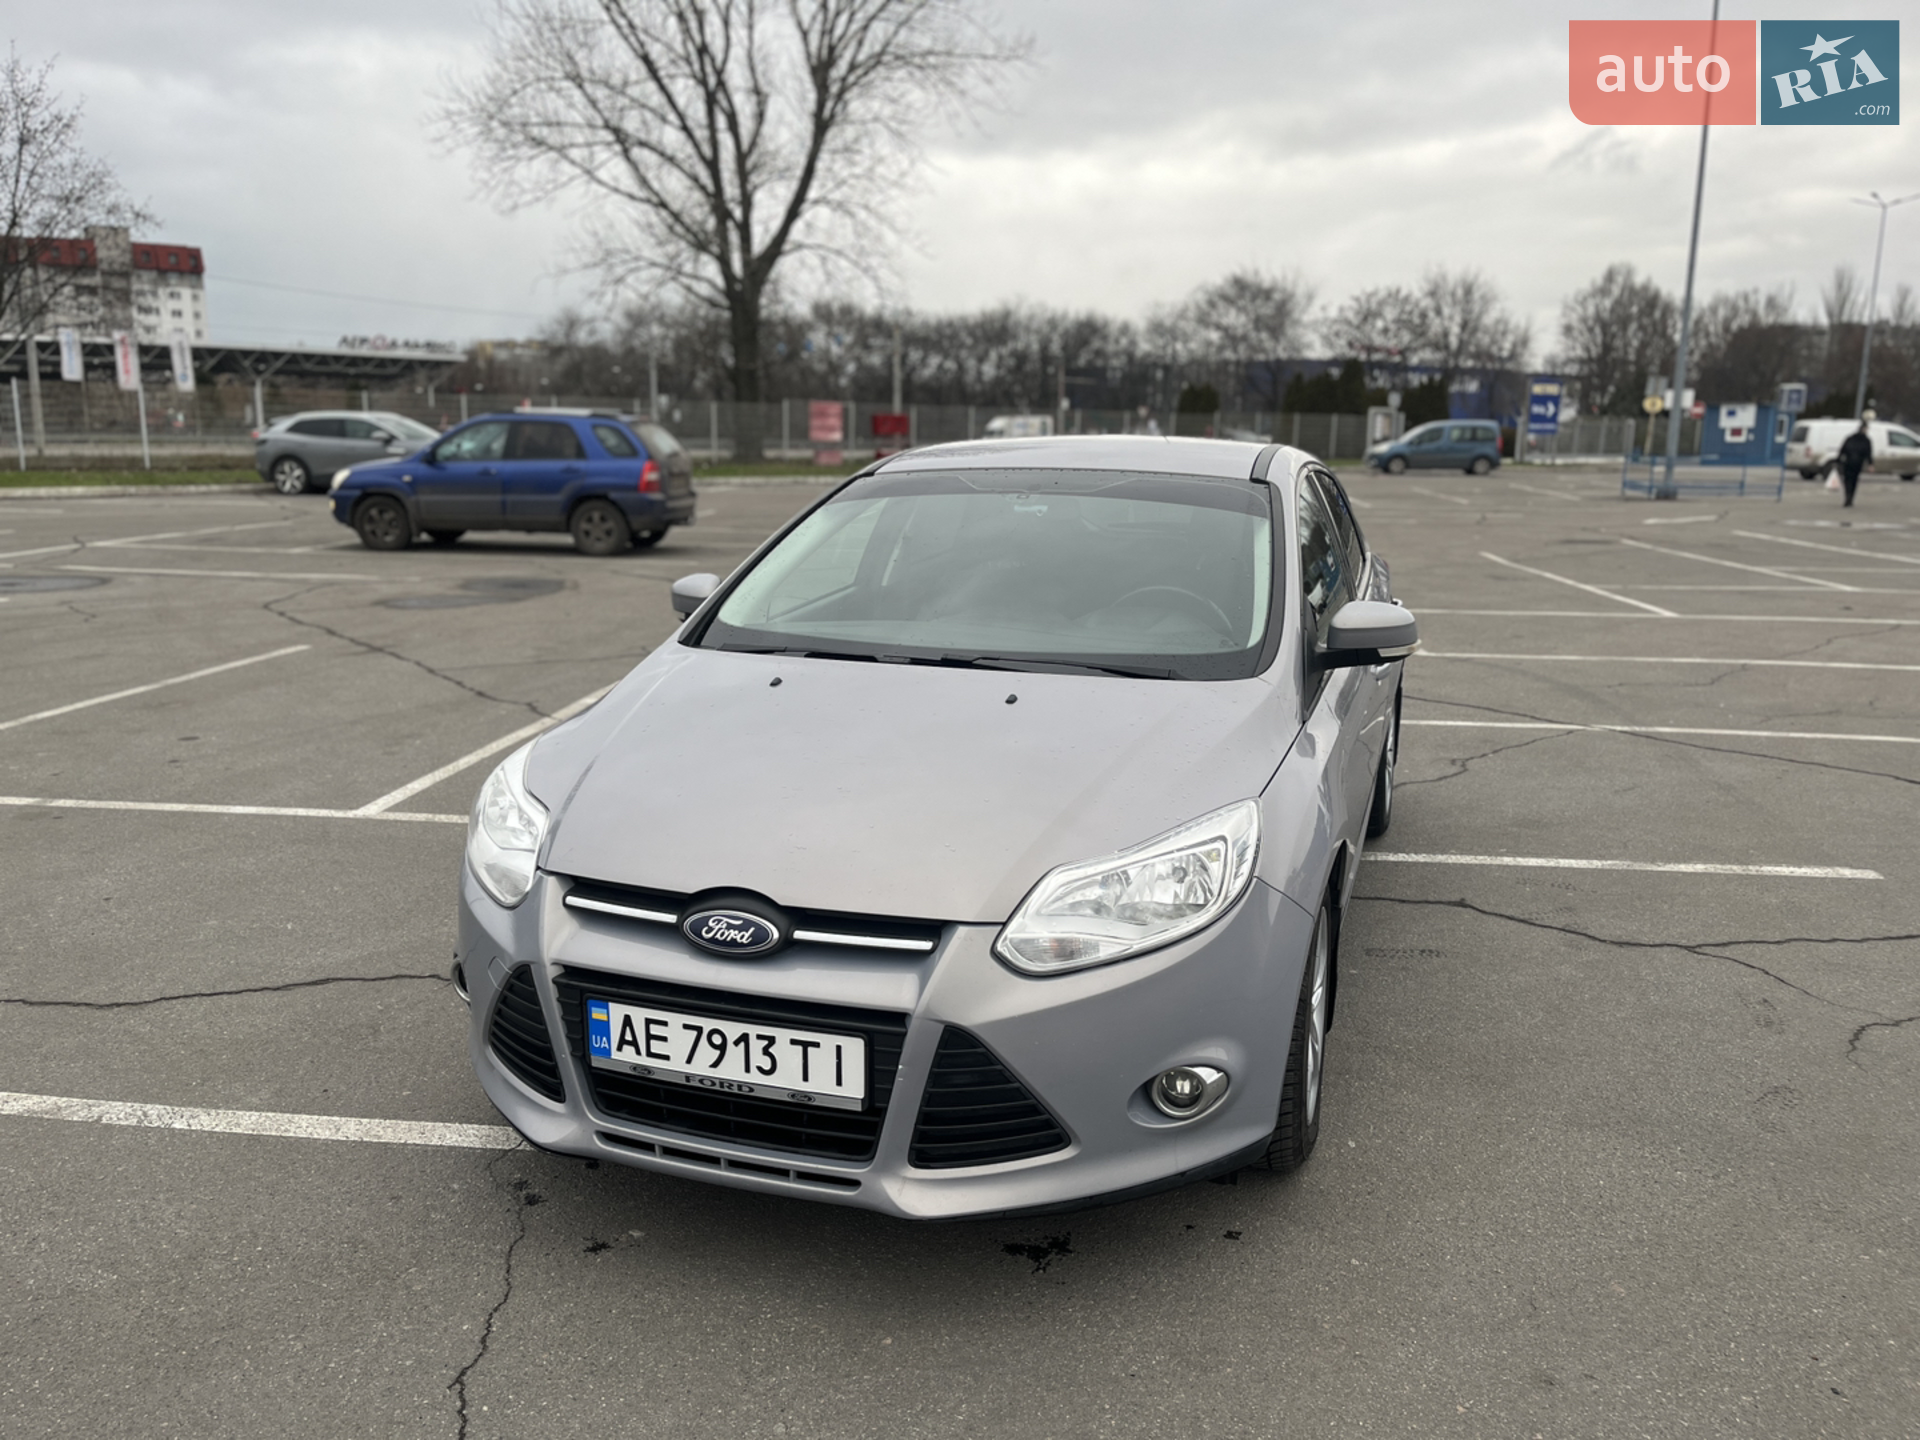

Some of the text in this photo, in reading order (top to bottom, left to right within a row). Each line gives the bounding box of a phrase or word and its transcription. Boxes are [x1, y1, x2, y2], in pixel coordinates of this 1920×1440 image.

[701, 916, 755, 944] Ford
[591, 1035, 609, 1050] UA
[616, 1013, 671, 1062] AE
[682, 1023, 778, 1076] 7913
[684, 1075, 755, 1094] FORD
